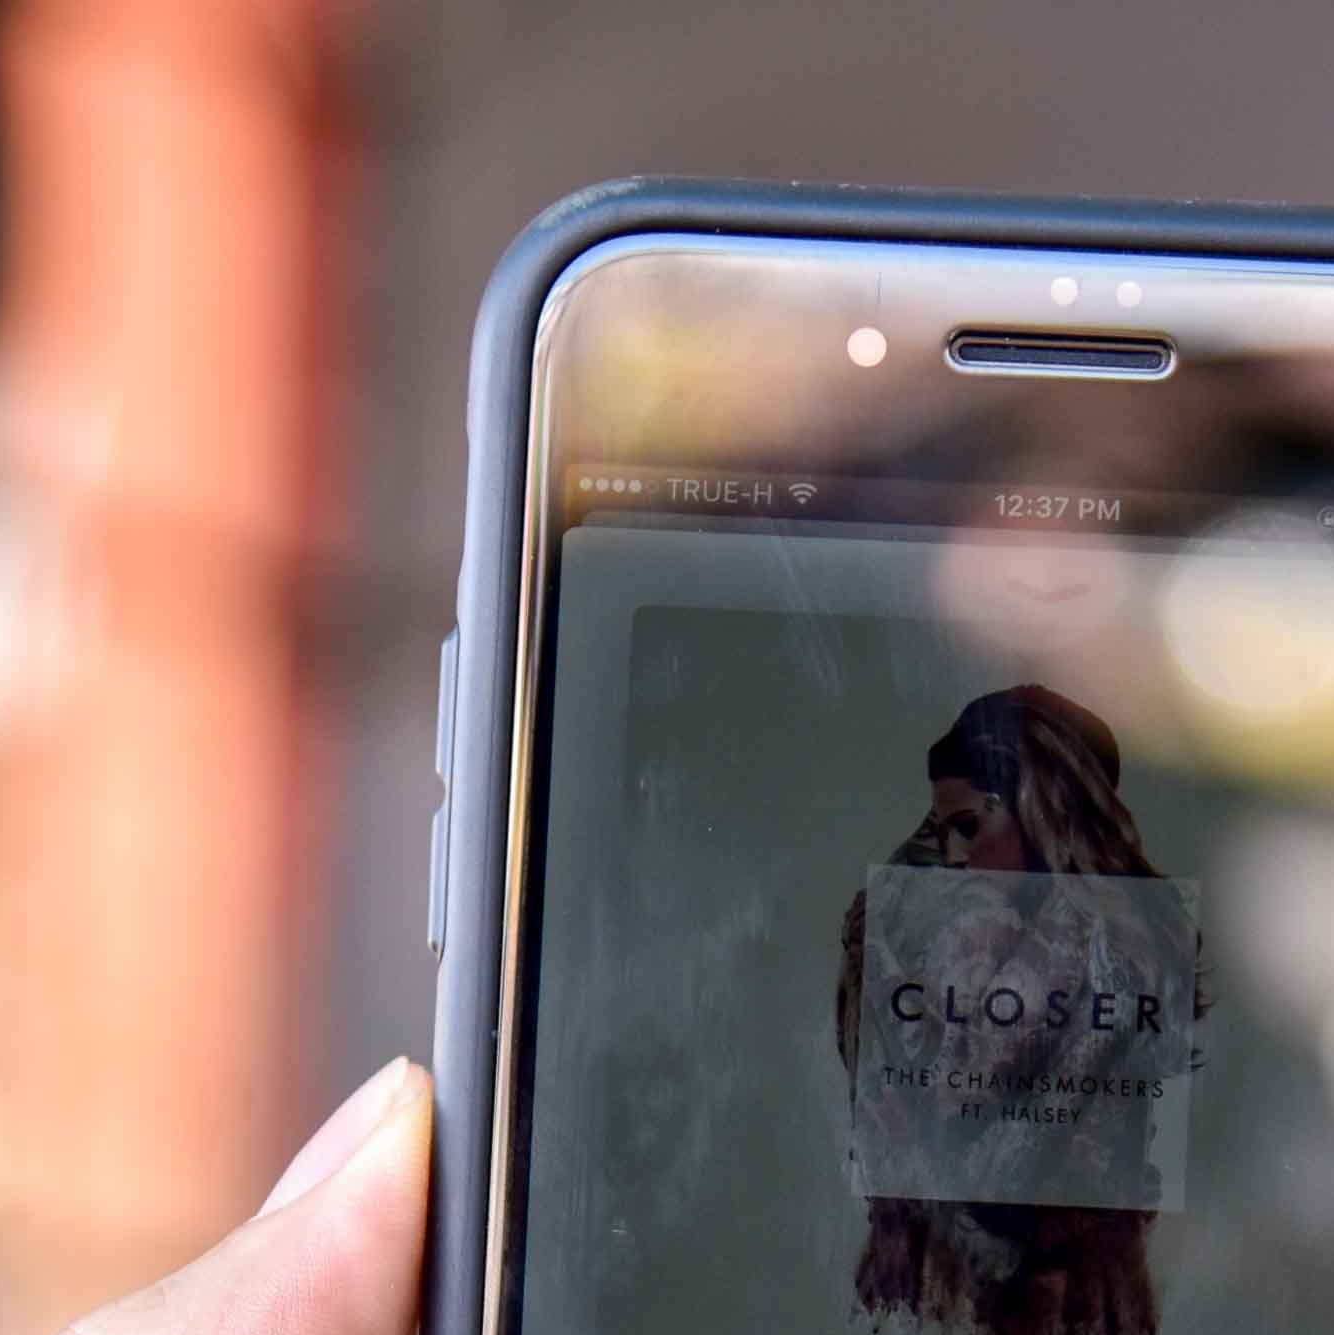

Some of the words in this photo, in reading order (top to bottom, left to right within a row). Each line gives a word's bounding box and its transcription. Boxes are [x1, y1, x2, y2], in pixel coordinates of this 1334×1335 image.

[666, 477, 773, 506] TRUE-H
[993, 492, 1071, 520] 12:37
[1078, 496, 1121, 522] PM
[890, 982, 1163, 1035] CLOSER
[883, 1066, 930, 1089] THE
[946, 1069, 1165, 1100] CHAINSMOKERS
[1001, 1104, 1083, 1125] HALSEY
